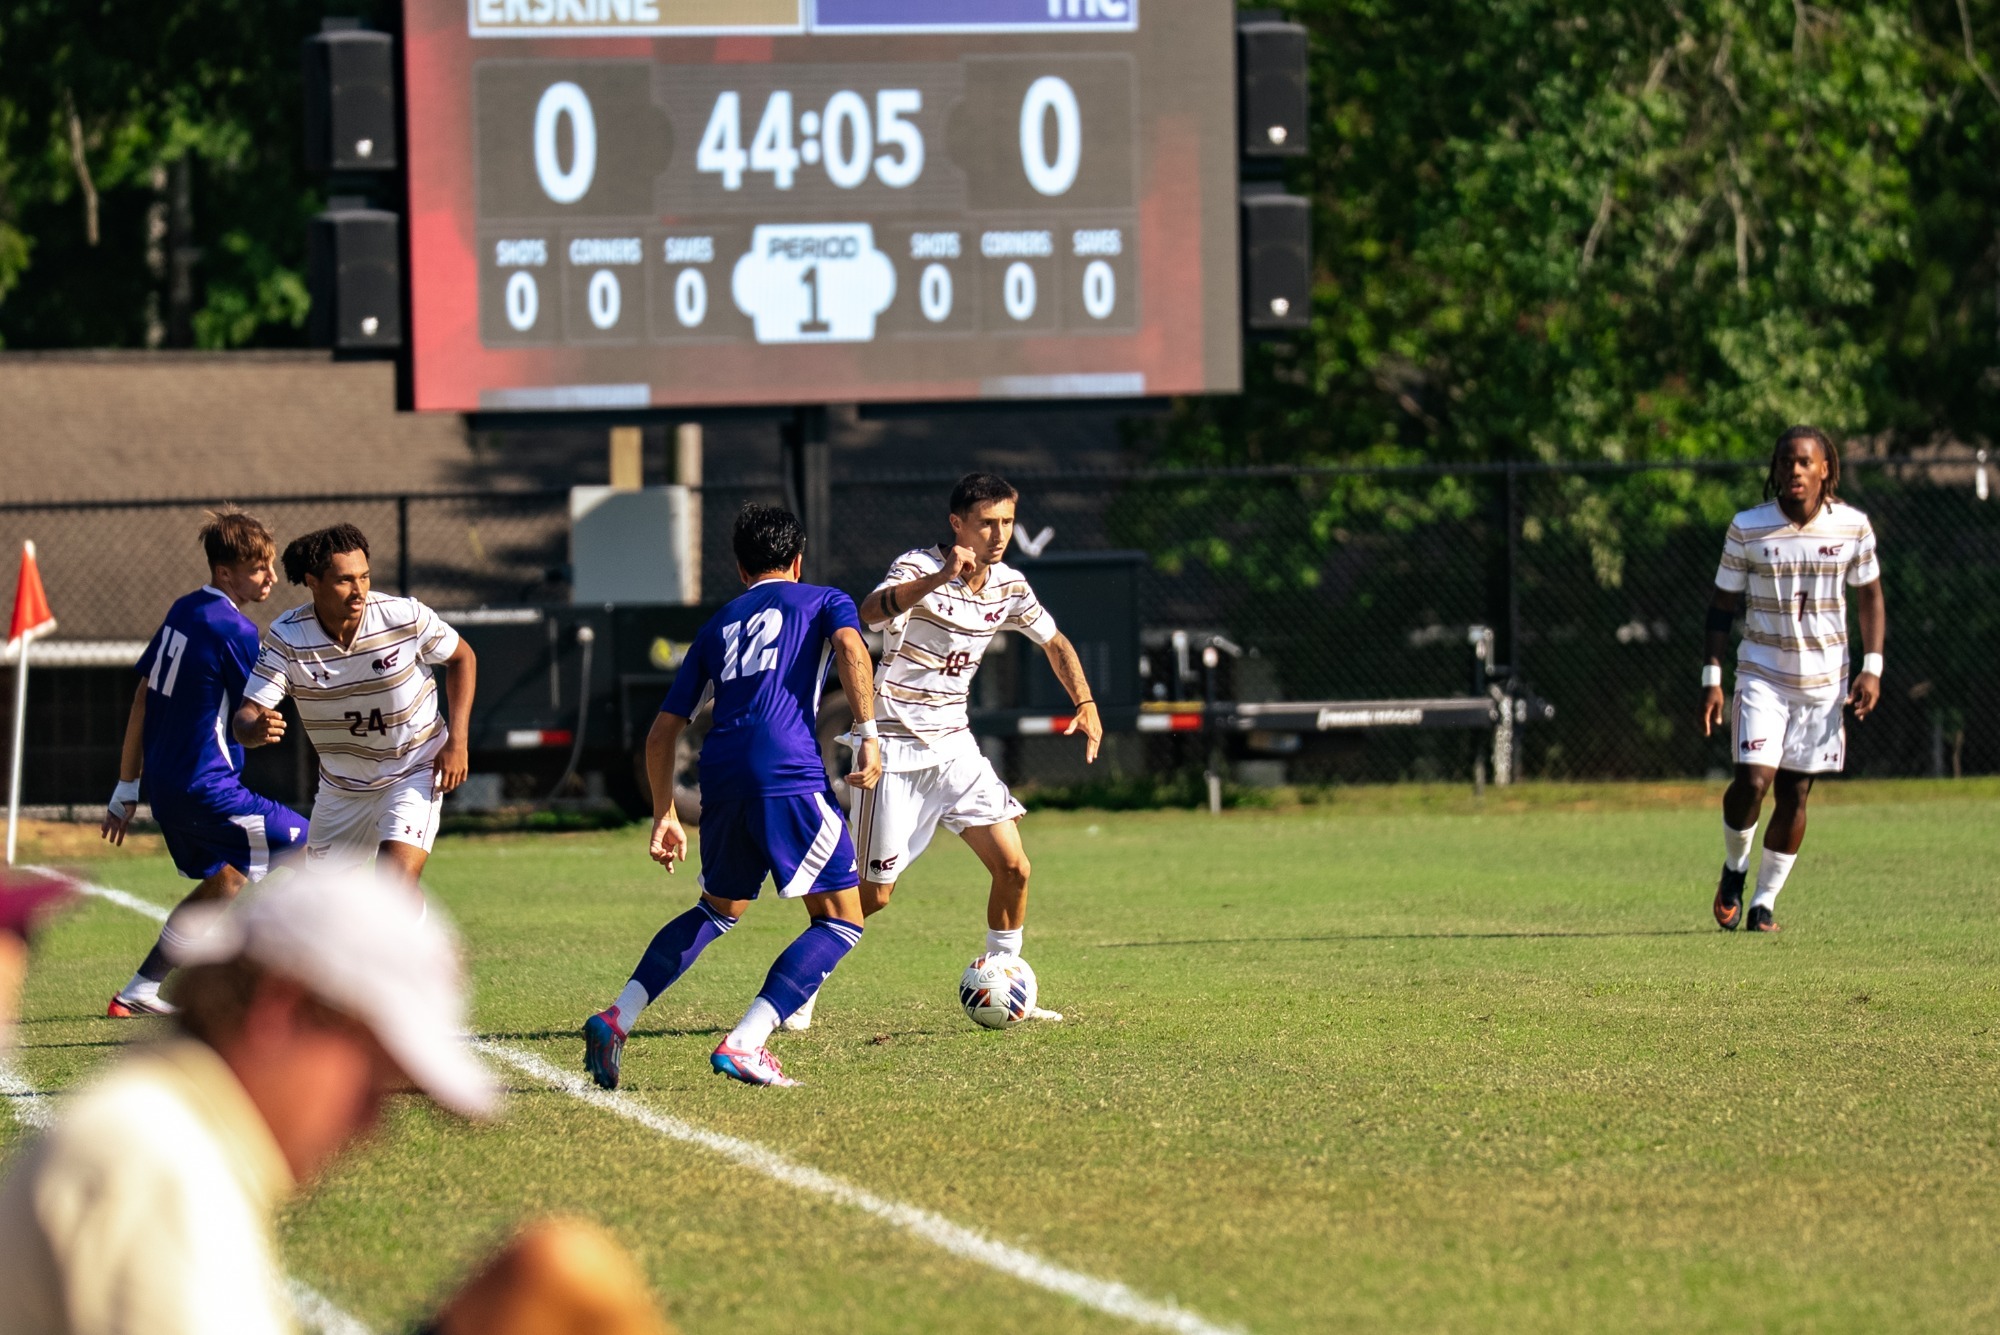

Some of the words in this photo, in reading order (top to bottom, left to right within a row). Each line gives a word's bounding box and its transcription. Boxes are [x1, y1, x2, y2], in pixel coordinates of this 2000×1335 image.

[534, 81, 597, 204] 0
[697, 90, 925, 191] 44:05
[1019, 75, 1082, 196] 0
[768, 236, 859, 259] PERIOD
[506, 270, 539, 332] 0
[588, 269, 621, 330] 0
[674, 267, 708, 328] 0
[800, 265, 830, 333] 1
[919, 262, 953, 323] 0
[1004, 261, 1037, 321] 0
[1082, 259, 1116, 320] 0
[1794, 590, 1809, 623] 7
[147, 625, 188, 698] 17
[720, 607, 783, 683] 12
[344, 707, 388, 737] 24
